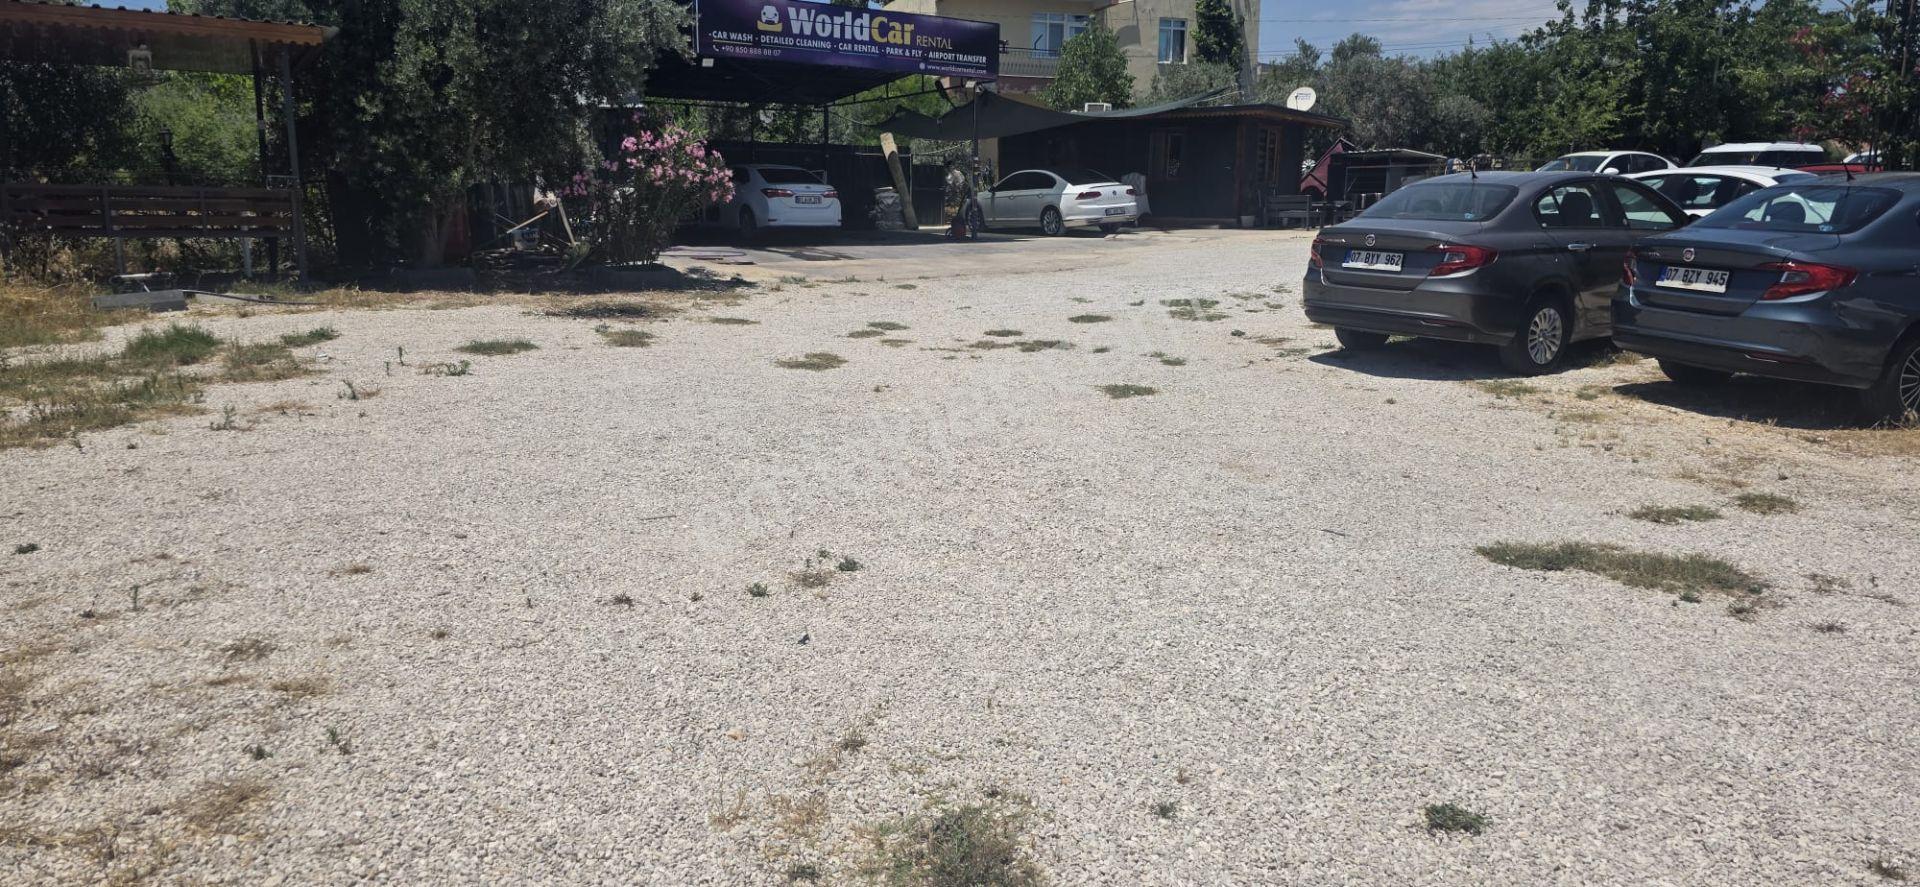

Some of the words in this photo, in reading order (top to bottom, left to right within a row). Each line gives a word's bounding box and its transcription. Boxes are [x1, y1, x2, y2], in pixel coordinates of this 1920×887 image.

[787, 7, 914, 45] WorldCar
[916, 35, 953, 50] RENTAL
[712, 31, 728, 40] CAR
[729, 32, 753, 42] WASH
[761, 35, 794, 46] DETAILED
[796, 38, 832, 49] CLEANING
[838, 42, 852, 51] CAR
[853, 44, 879, 54] RENTAL
[886, 47, 904, 56] PARK
[912, 49, 922, 57] FLY
[928, 51, 955, 61] AIRPORT
[956, 54, 987, 63] TRANSFER
[1351, 252, 1360, 263] 07
[1364, 252, 1381, 265] BYY
[1385, 254, 1401, 266] 962
[1666, 268, 1678, 281] 07
[1682, 269, 1702, 284] BZY
[1706, 272, 1727, 286] 945
